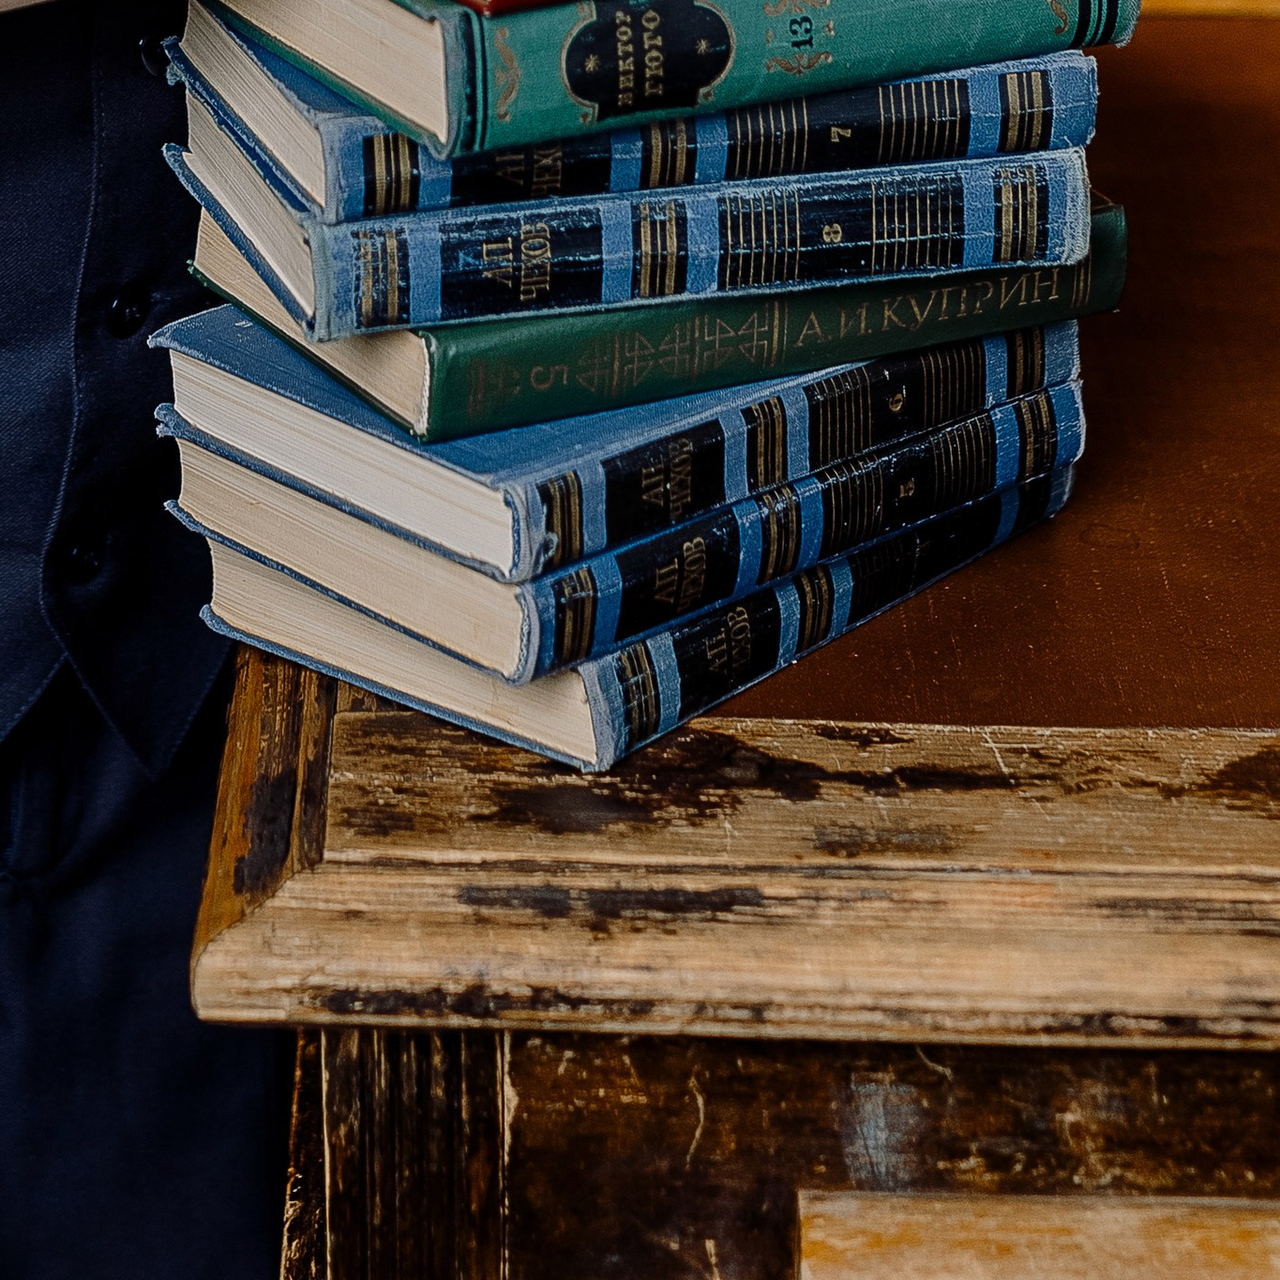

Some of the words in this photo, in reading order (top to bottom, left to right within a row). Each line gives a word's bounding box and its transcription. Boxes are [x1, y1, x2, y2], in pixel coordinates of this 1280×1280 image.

[615, 9, 636, 107] ВИКТОР
[641, 8, 664, 98] ГЮГО
[788, 15, 815, 51] 13
[830, 126, 852, 143] 7
[520, 221, 552, 301] ЧЕХОВ
[822, 222, 843, 244] 8
[880, 267, 1060, 332] КУПРИН
[888, 392, 904, 413] 6
[676, 536, 707, 615] ЧЕХОВ
